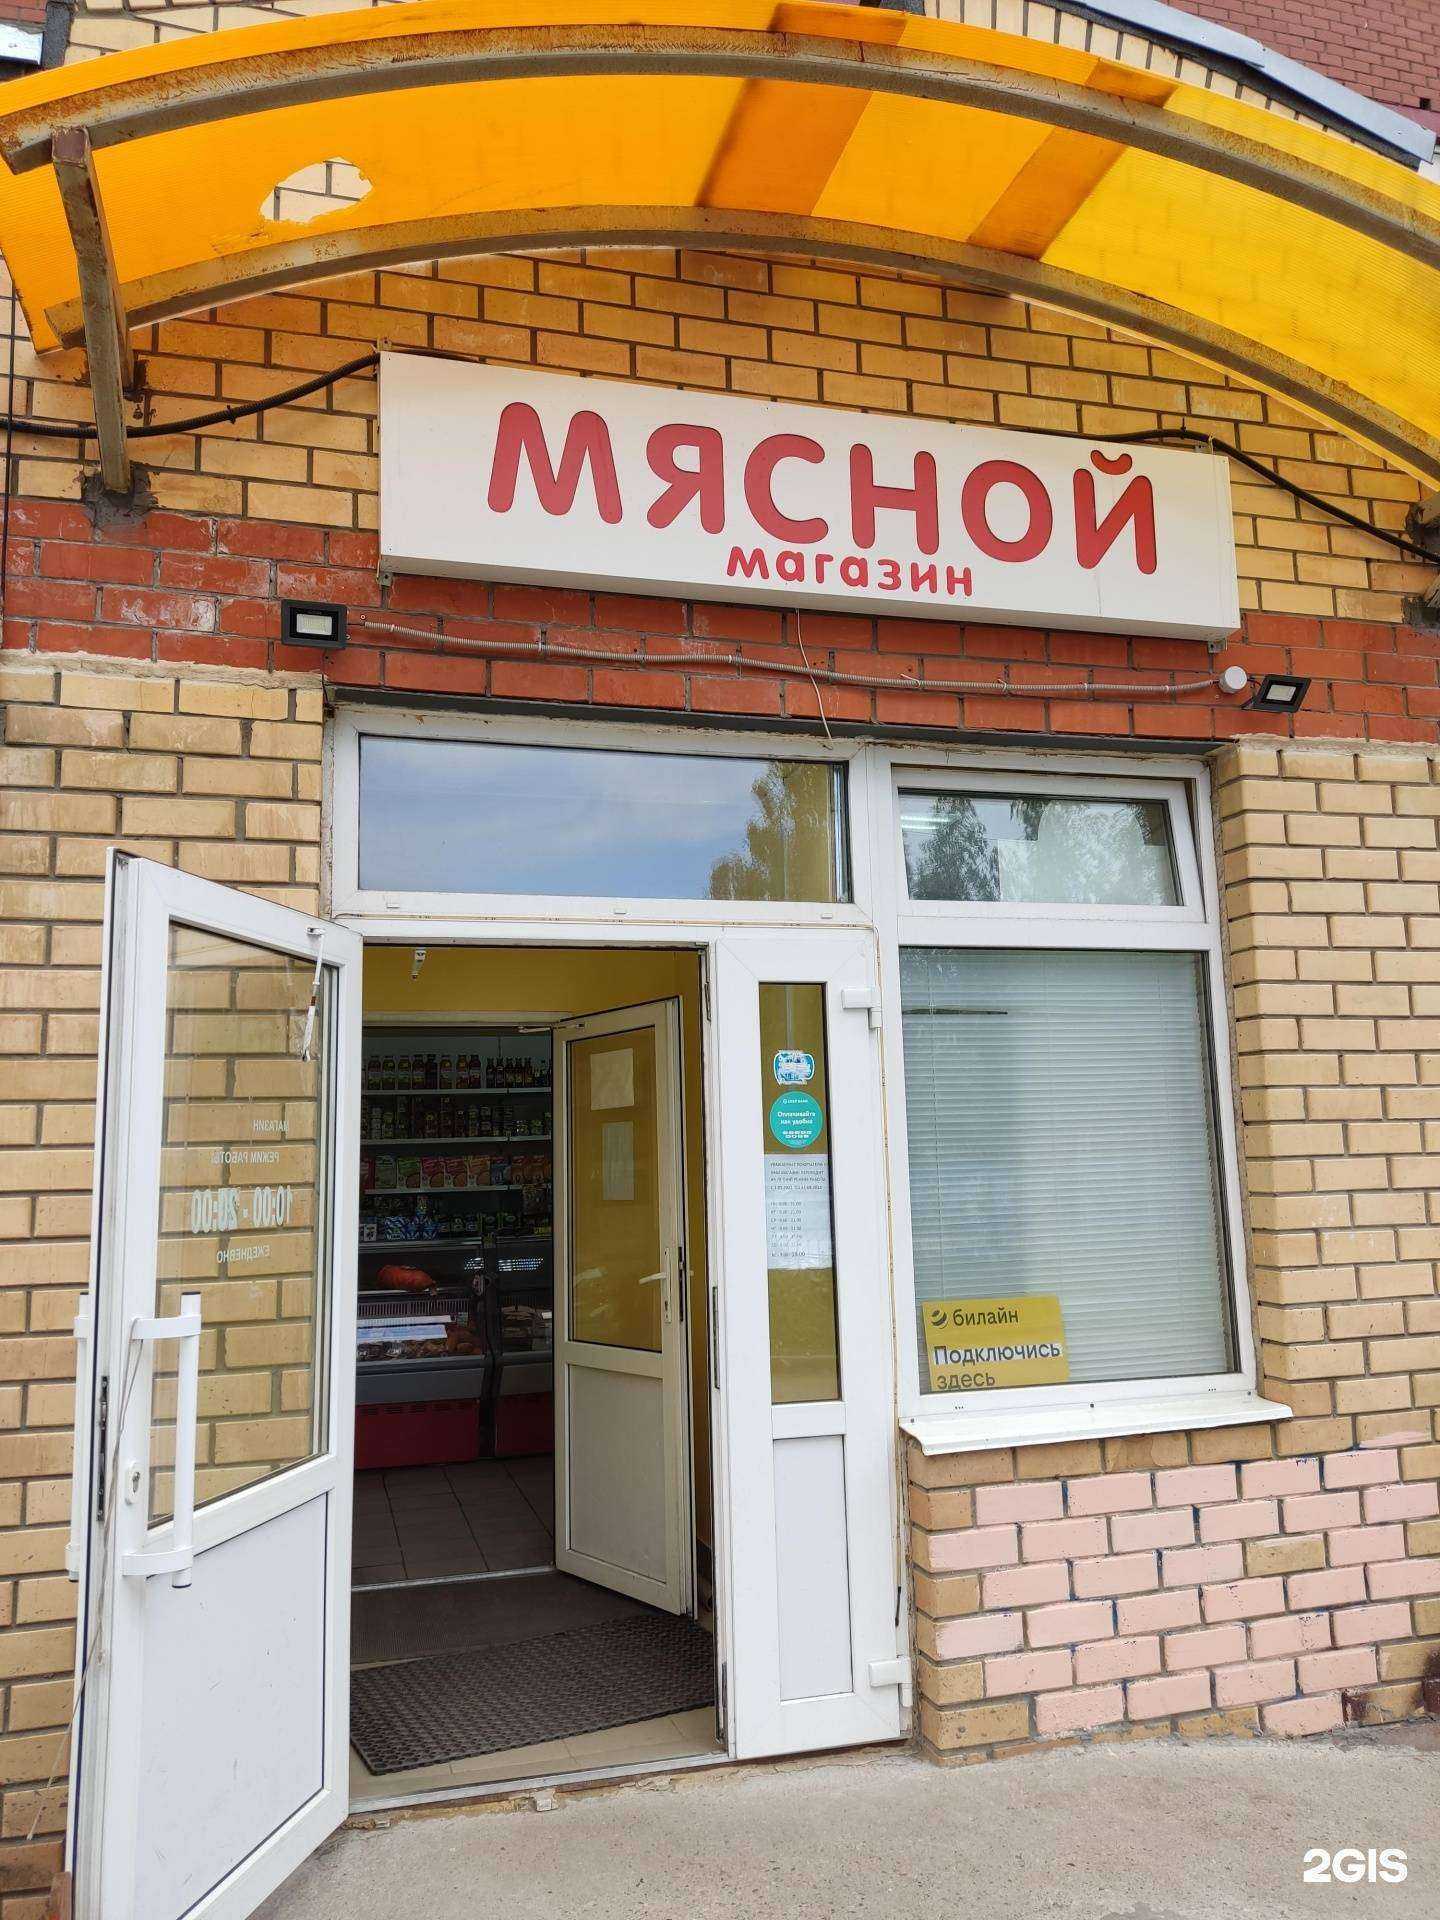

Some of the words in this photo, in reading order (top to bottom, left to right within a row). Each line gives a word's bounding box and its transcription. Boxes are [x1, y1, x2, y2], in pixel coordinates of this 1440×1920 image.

[488, 401, 1158, 576] МЯСНОЙ
[727, 545, 973, 596] магазин
[953, 1307, 1019, 1327] билайн
[934, 1343, 1061, 1367] Подключись
[936, 1372, 996, 1390] здесь
